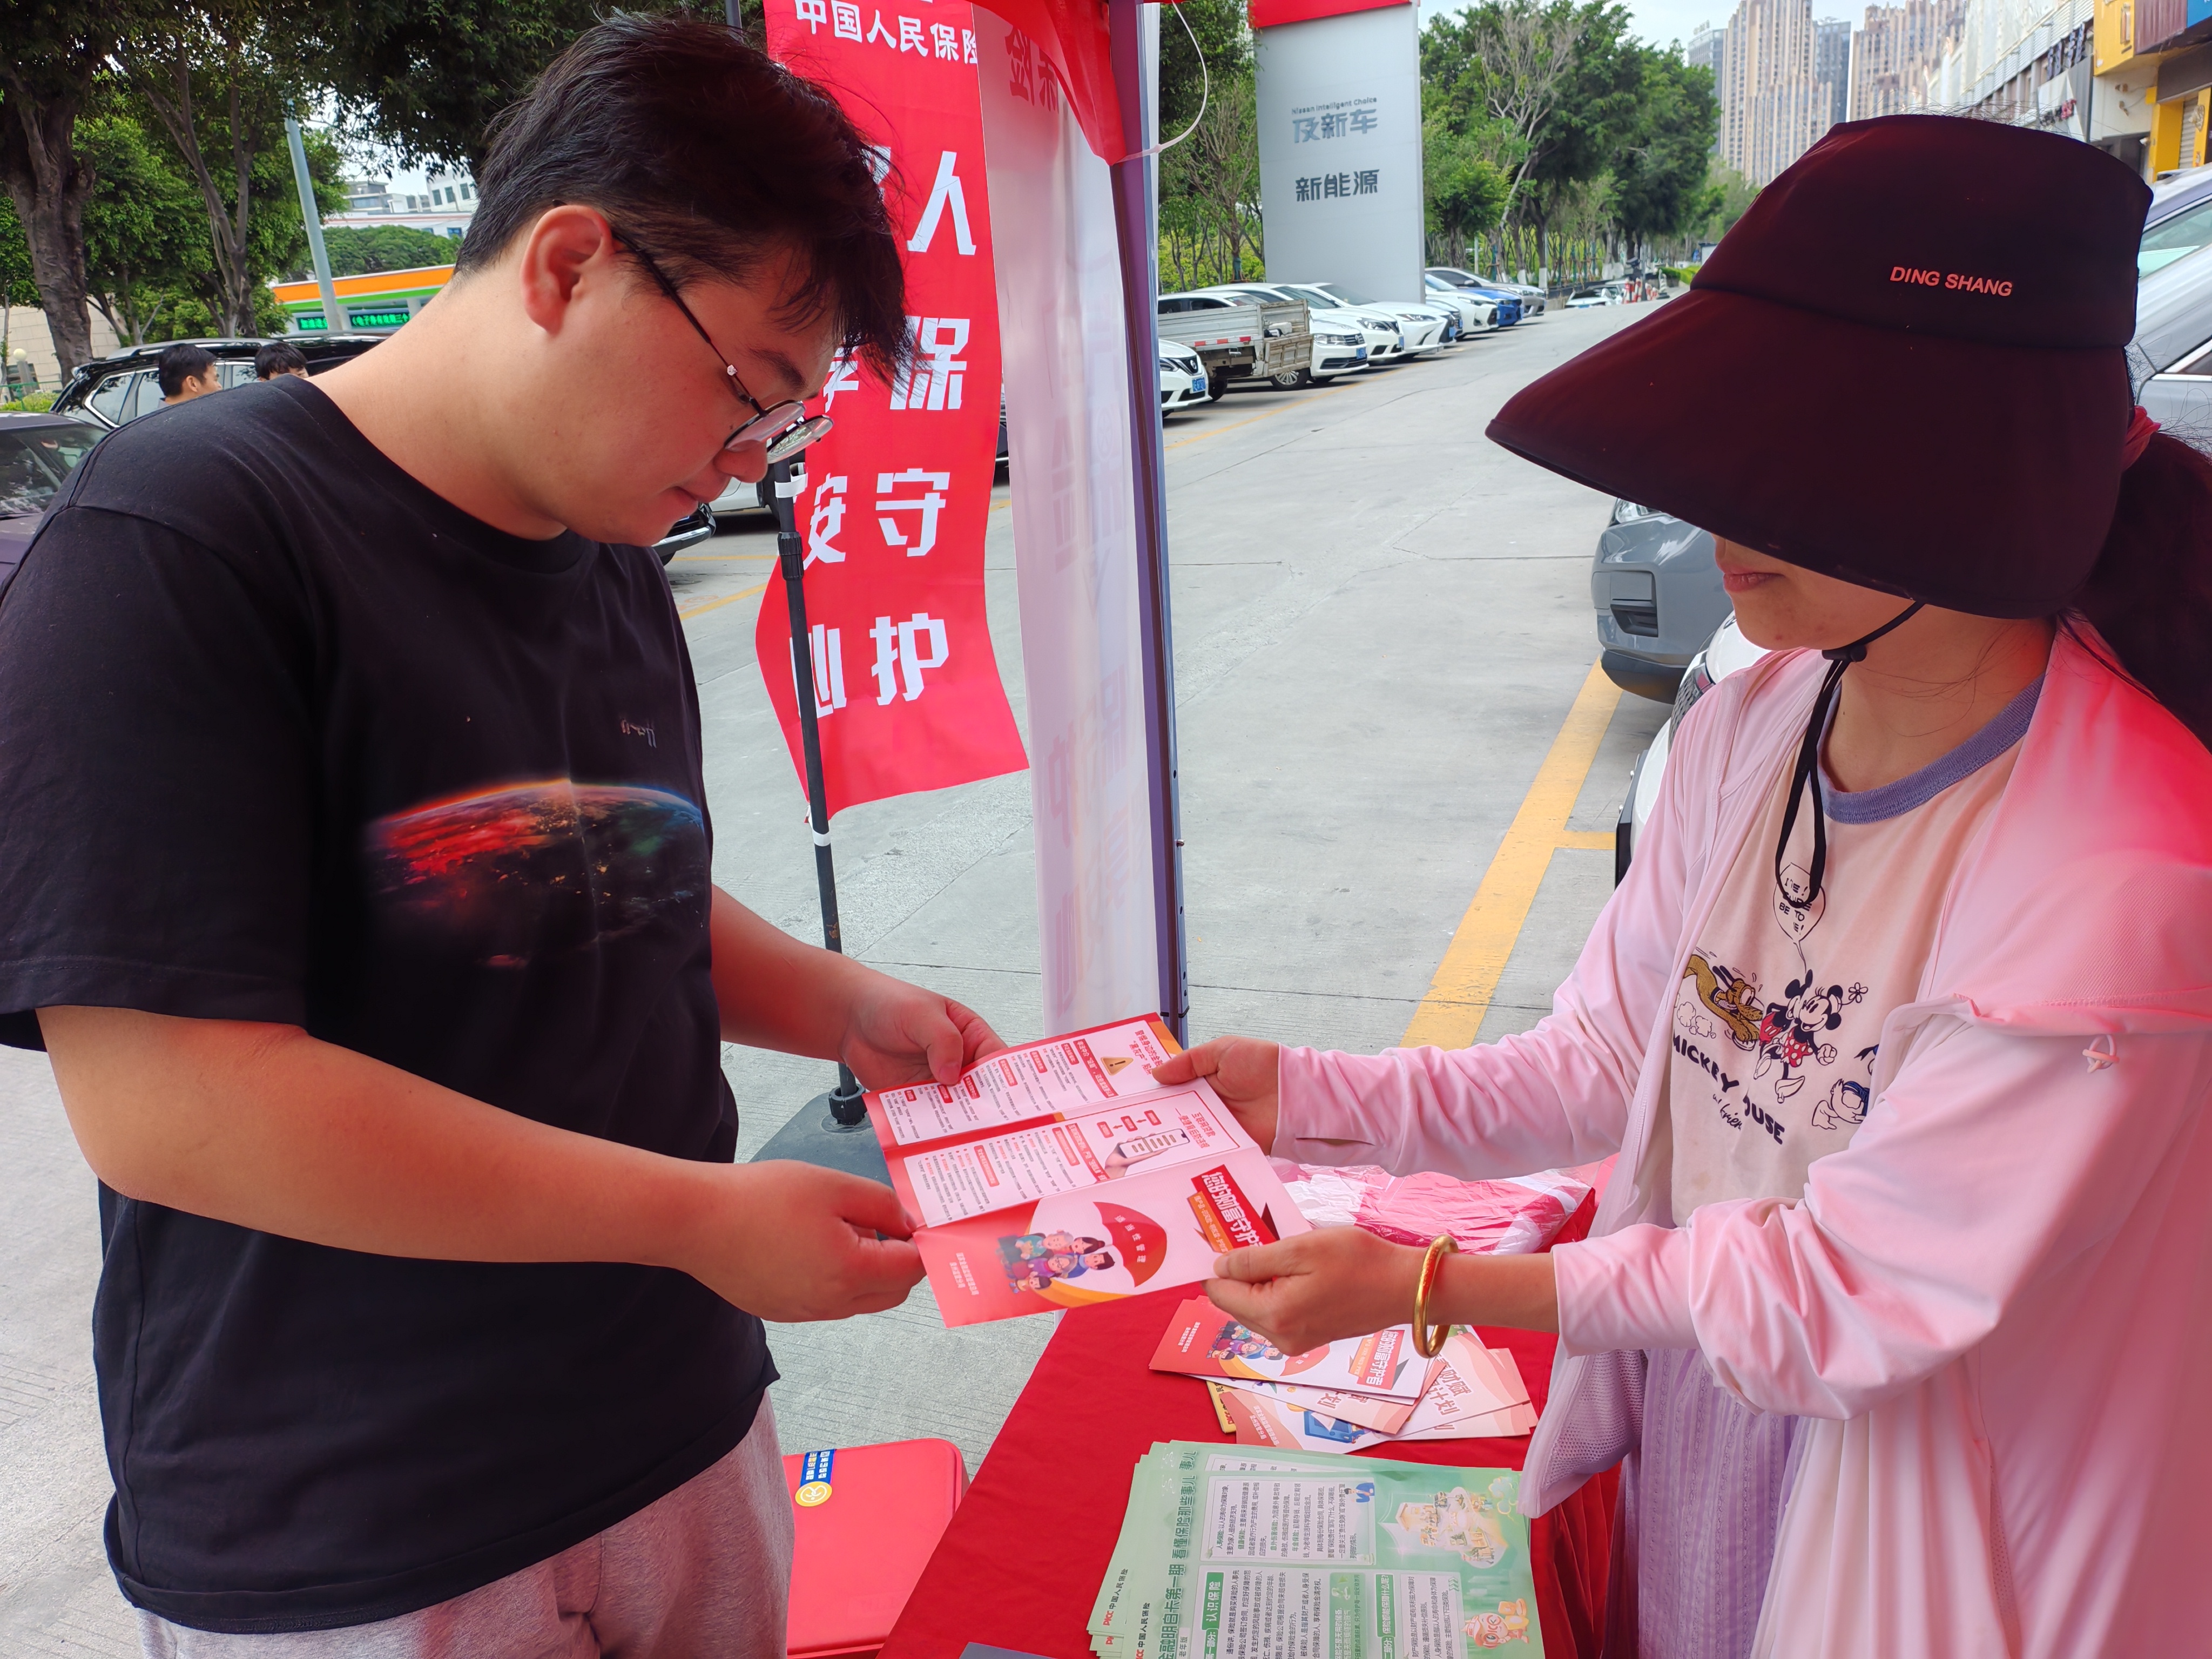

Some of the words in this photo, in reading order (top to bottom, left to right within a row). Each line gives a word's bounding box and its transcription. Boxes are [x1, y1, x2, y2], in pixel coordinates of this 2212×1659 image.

[795, 0, 977, 64] 中国人民保险
[1353, 97, 1377, 106] Choice
[1296, 169, 1379, 202] 新能源
[1890, 267, 1940, 286] DING
[1945, 273, 2013, 296] SHANG
[1201, 1171, 1265, 1247] 您的财富守护
[1365, 1330, 1399, 1386] 您的财富守护者
[1109, 1568, 1128, 1609] 中国人民保险
[1158, 1564, 1185, 1659] 金融明白卡第一期
[1172, 1476, 1195, 1559] 看懂保险那些事儿
[1205, 1581, 1220, 1622] 认识保险
[1312, 1578, 1321, 1659] 合同保障的人，享有保险金请求权。
[1137, 1602, 1150, 1648] 中国人民保险
[1179, 1636, 1188, 1657] 老年版
